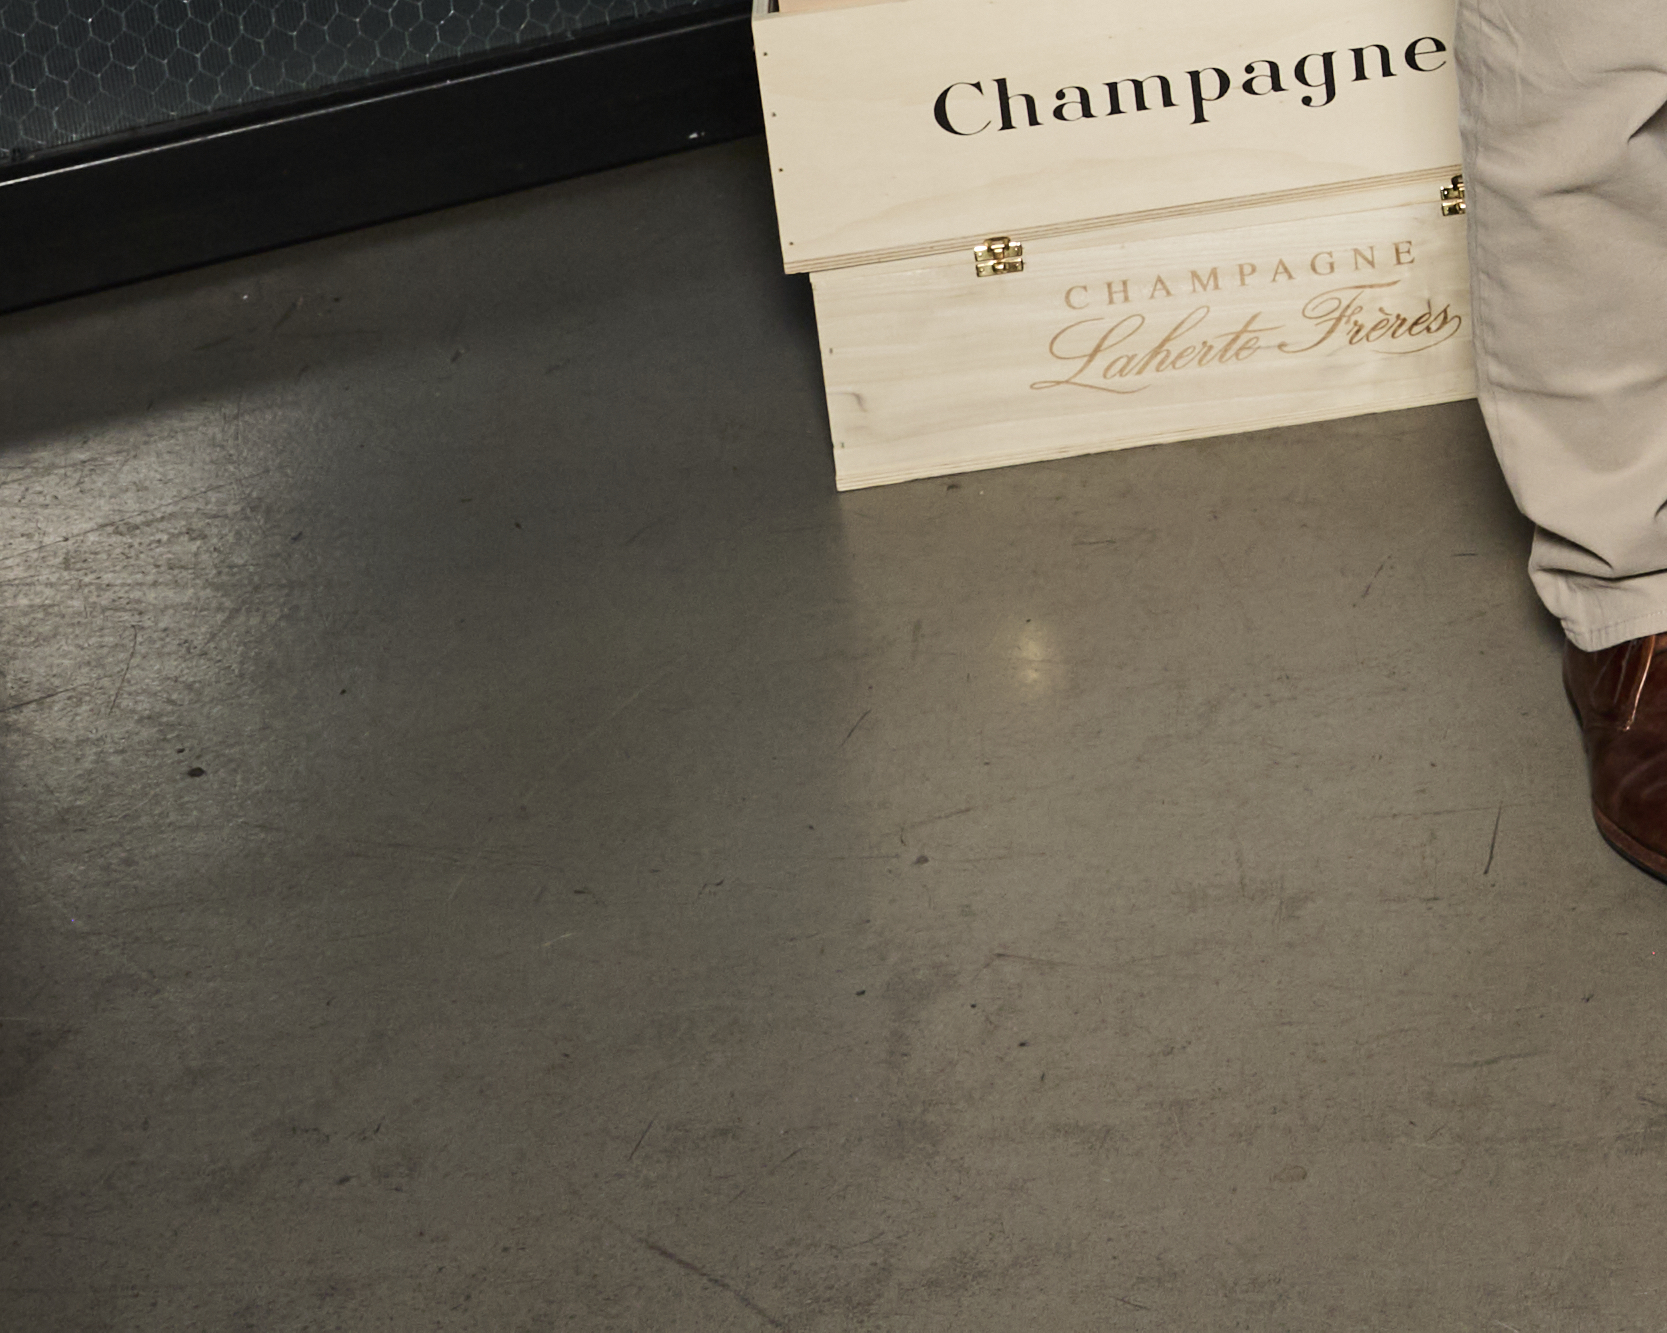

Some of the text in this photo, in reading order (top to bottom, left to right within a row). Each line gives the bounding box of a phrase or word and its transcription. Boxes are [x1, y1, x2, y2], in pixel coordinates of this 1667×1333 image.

[933, 35, 1448, 137] Champagne
[1063, 240, 1417, 311] CHAMPAGNE
[1029, 279, 1463, 395] Laherte Frères
